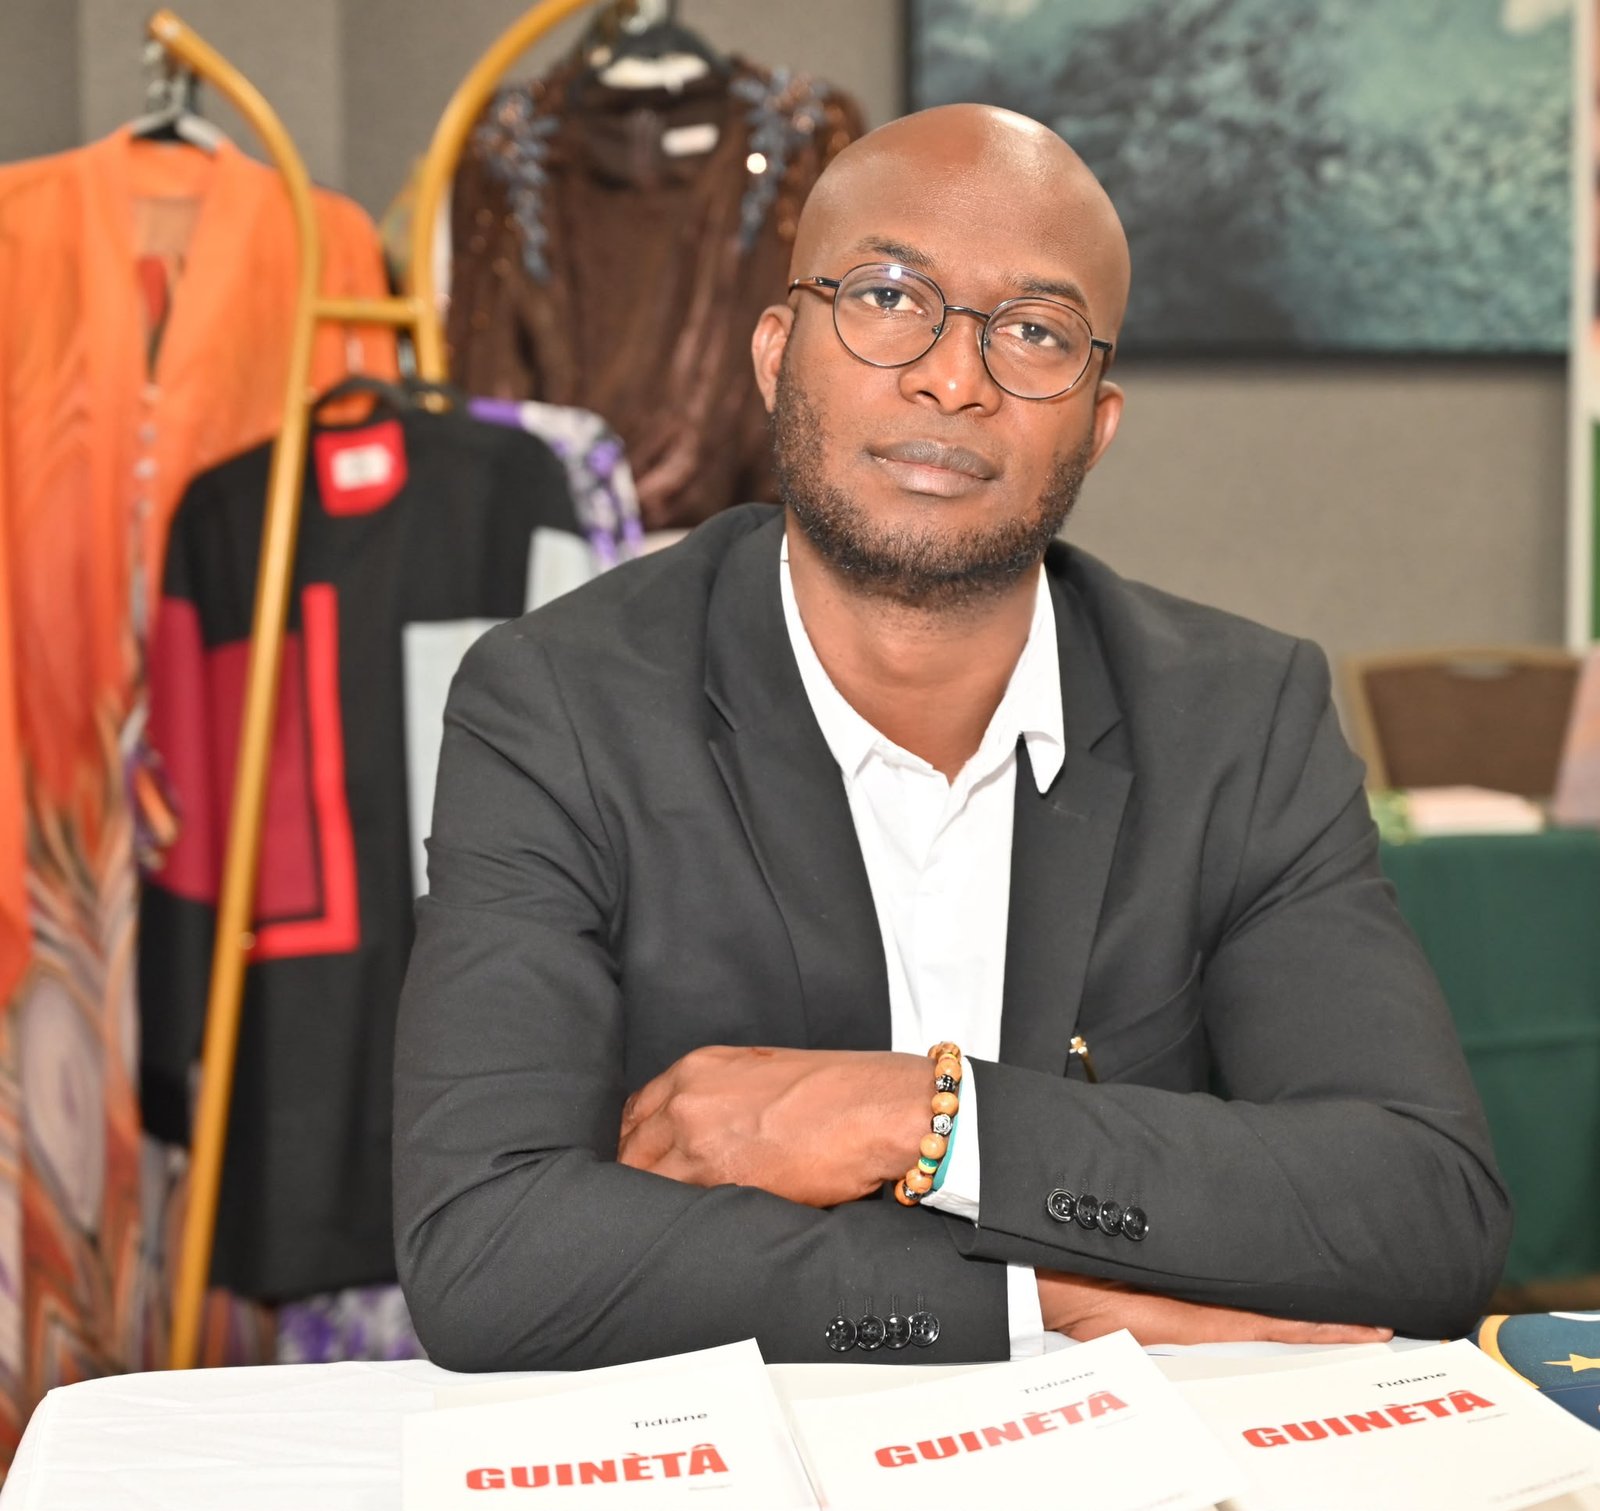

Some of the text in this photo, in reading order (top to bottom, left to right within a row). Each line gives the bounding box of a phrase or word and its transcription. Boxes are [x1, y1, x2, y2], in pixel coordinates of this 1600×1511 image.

[1020, 1371, 1095, 1394] Tidiane
[1372, 1373, 1446, 1388] Tidiane
[632, 1413, 708, 1429] Tidiane
[874, 1391, 1128, 1468] GUINÈTÂ
[1242, 1390, 1496, 1448] GUINÈTÂ
[466, 1443, 729, 1491] GUINÈTÂ
